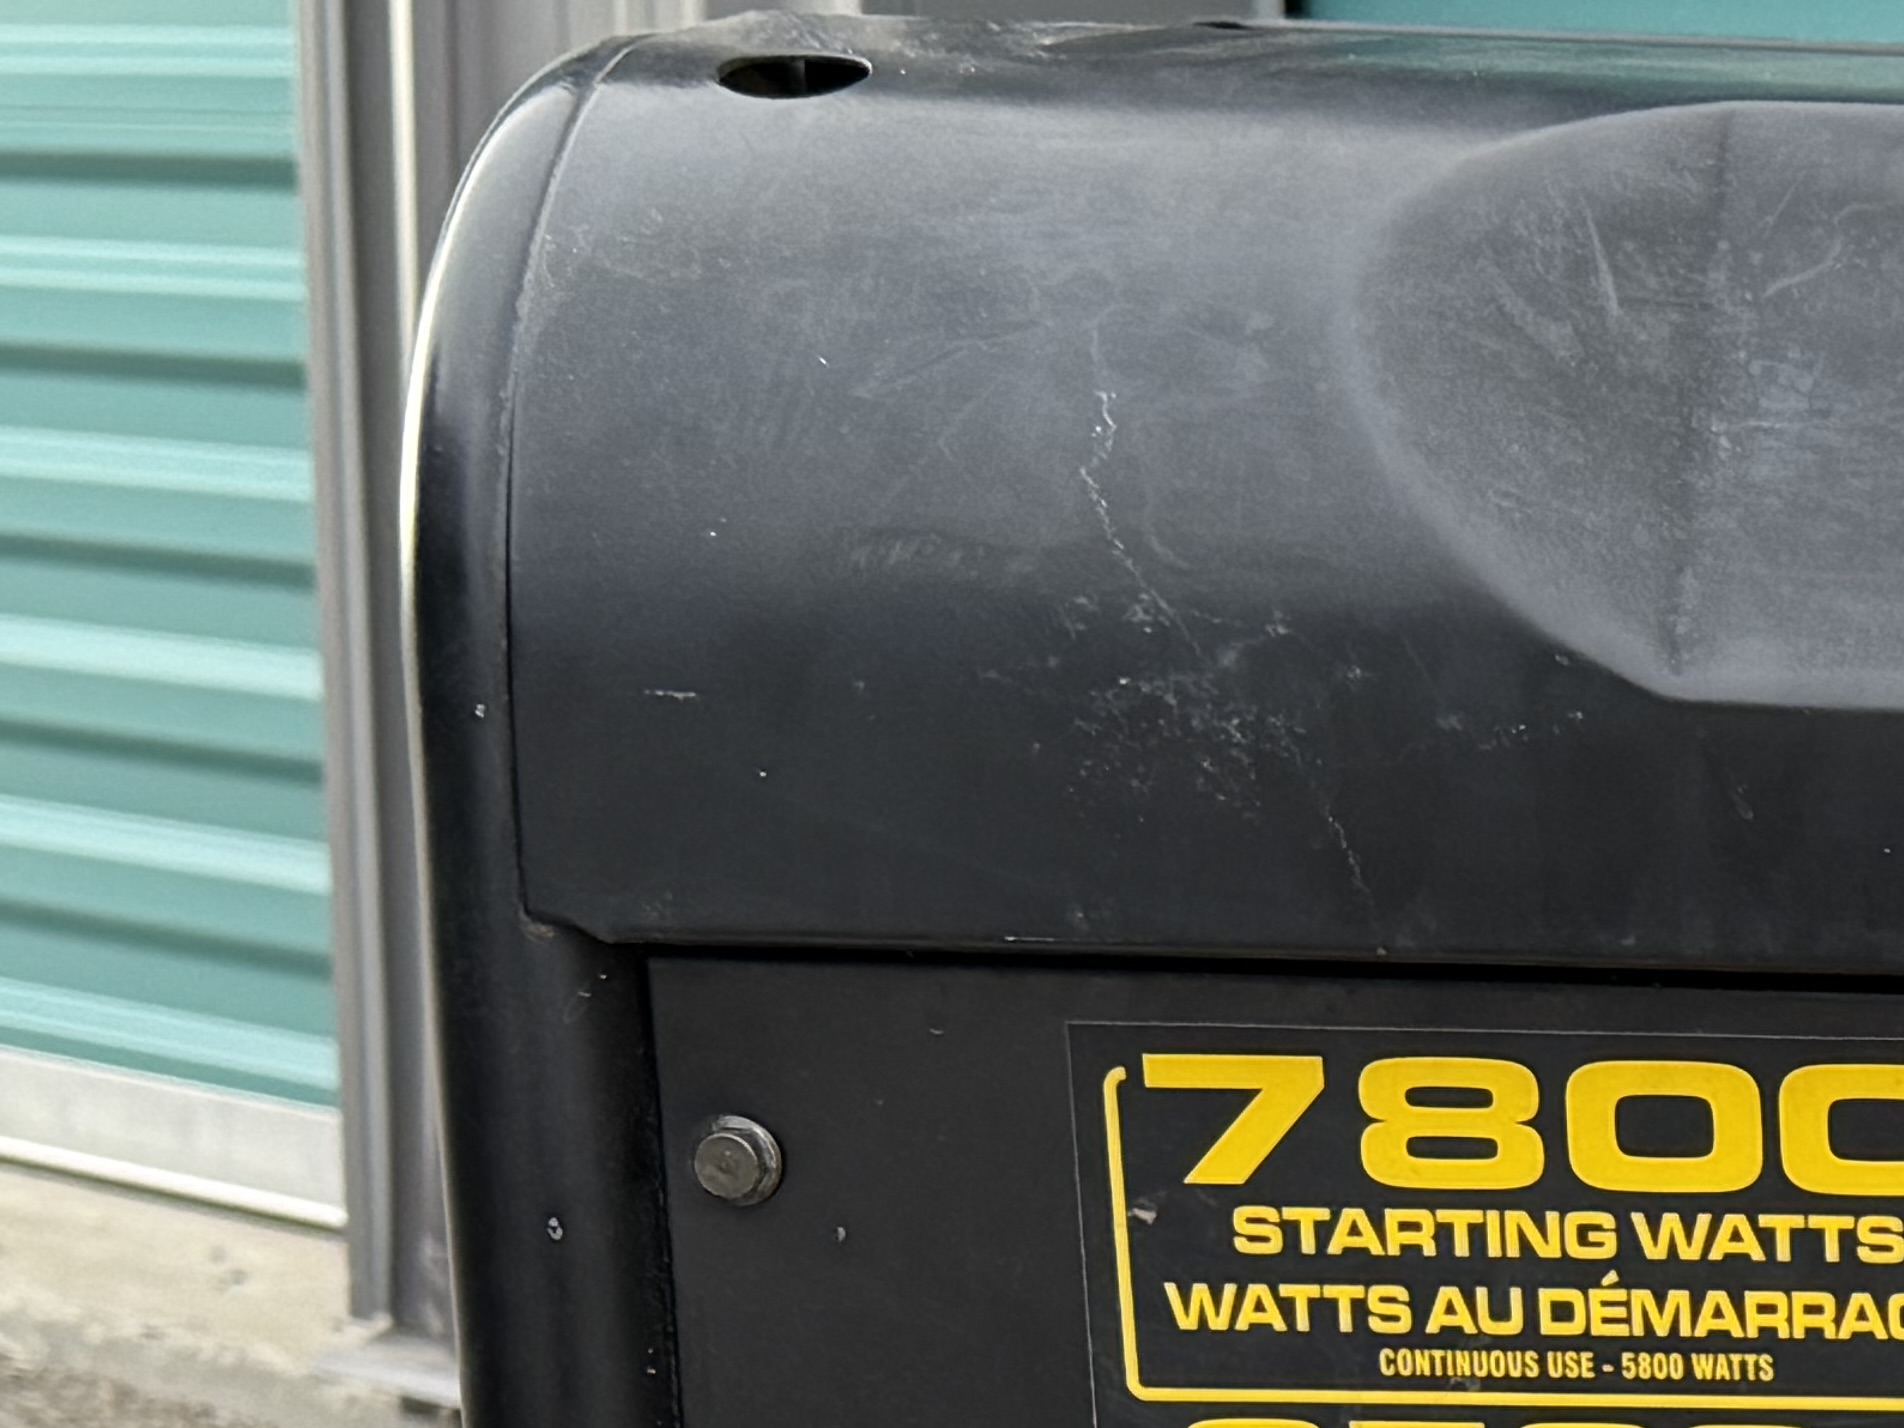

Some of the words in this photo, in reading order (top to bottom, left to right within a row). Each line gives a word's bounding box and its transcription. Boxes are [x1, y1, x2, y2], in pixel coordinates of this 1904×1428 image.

[1232, 1205, 1617, 1259] STARTING
[1163, 1281, 1412, 1334] WATTS
[1425, 1285, 1523, 1335] AU
[1379, 1348, 1539, 1378] CONTINUOUS
[1546, 1350, 1595, 1378] USE
[1621, 1352, 1684, 1380] 5800
[1690, 1352, 1774, 1381] WATTS
